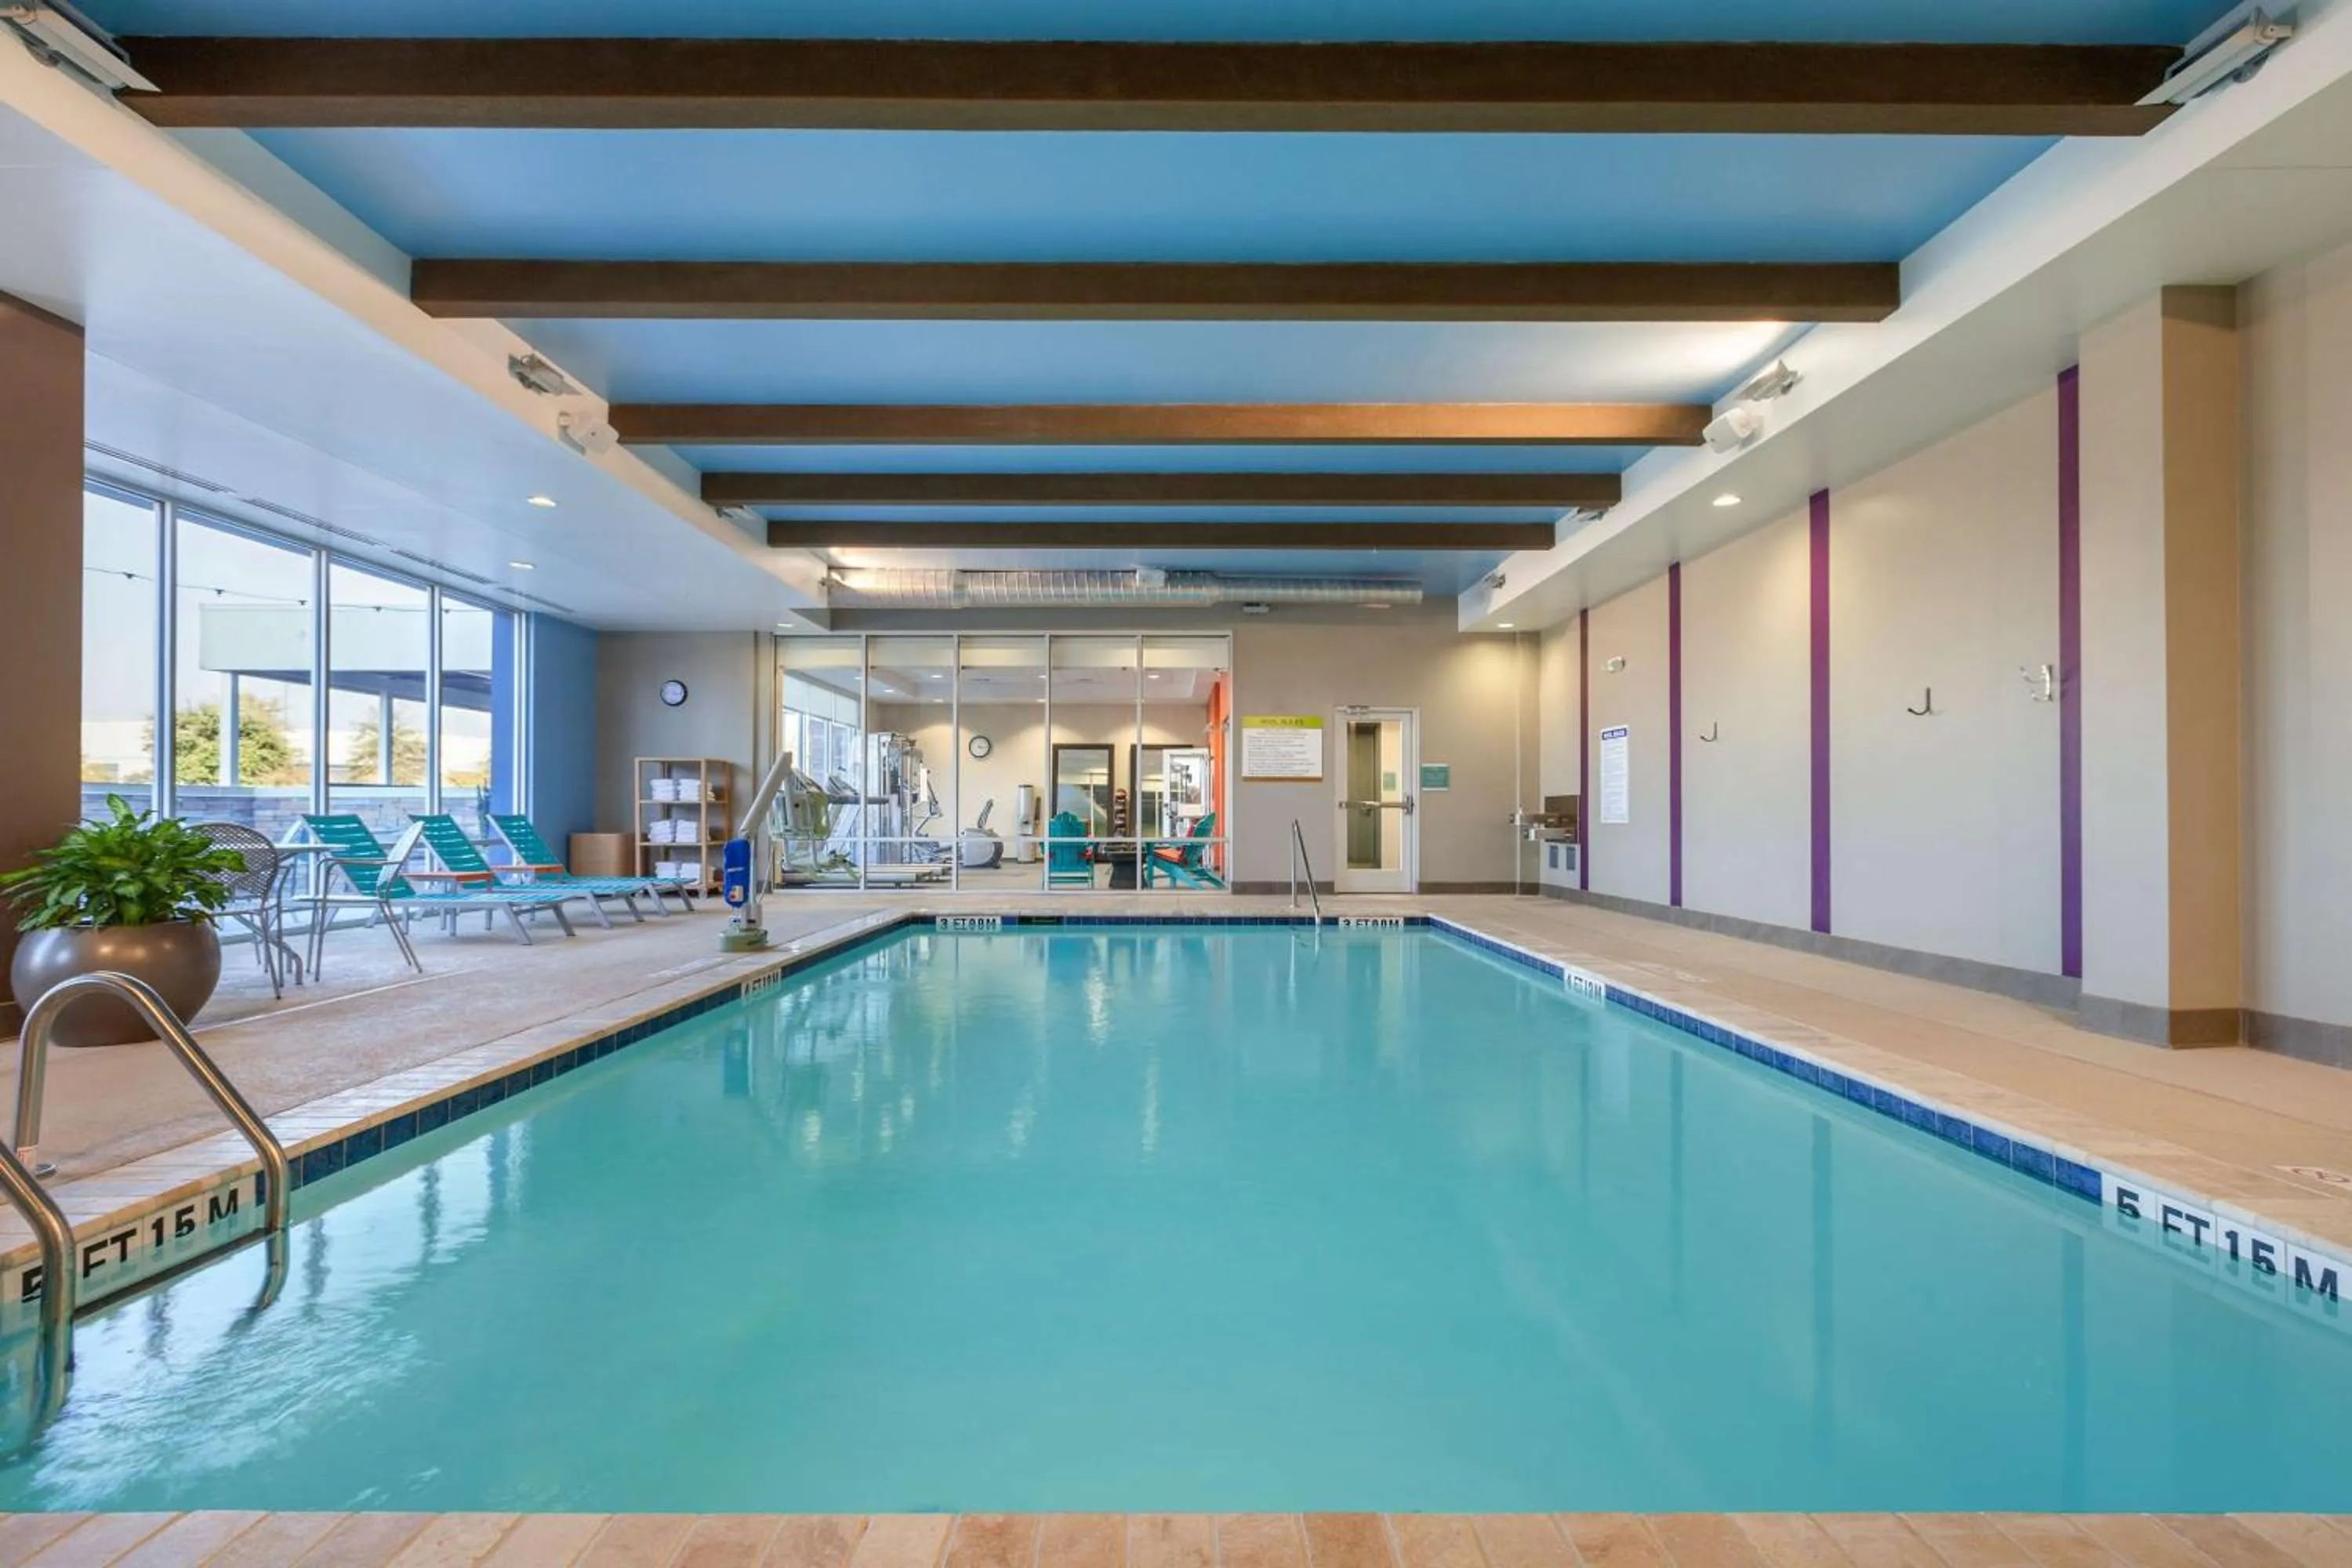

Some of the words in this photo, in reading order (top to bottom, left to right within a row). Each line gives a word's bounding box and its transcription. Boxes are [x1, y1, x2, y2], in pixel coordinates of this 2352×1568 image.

[82, 1228, 137, 1279] FT
[151, 1204, 196, 1247] 15
[209, 1188, 239, 1225] M
[2117, 1186, 2141, 1219] 5
[2161, 1203, 2210, 1247] FT
[2224, 1229, 2277, 1276] 15
[2295, 1255, 2339, 1303] M
